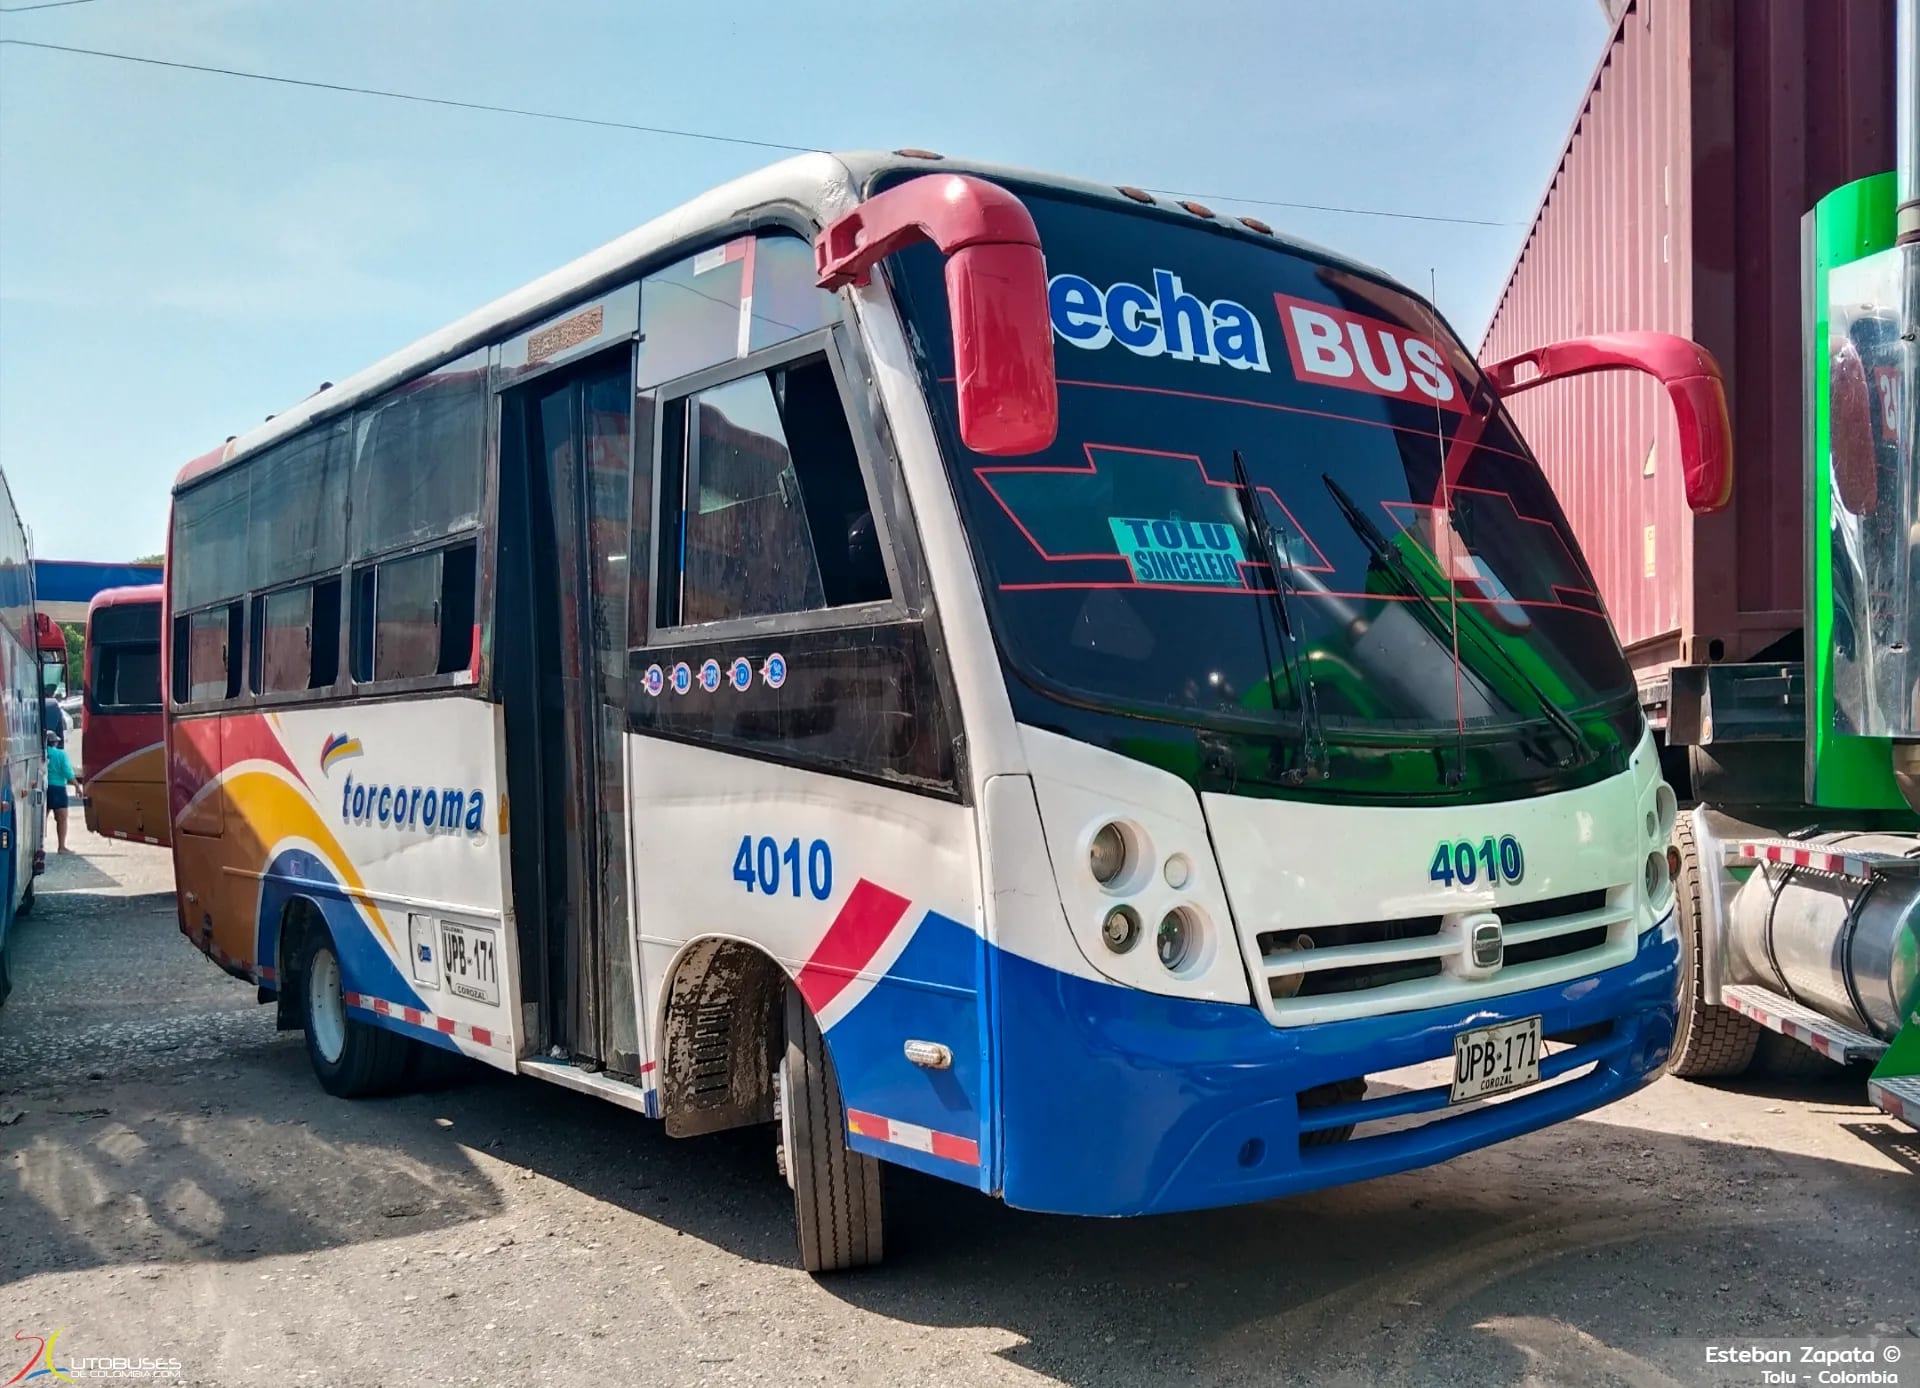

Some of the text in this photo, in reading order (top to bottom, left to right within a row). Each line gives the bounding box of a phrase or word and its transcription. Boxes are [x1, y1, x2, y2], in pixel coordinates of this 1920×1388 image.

[1047, 266, 1454, 401] echa BUS
[1122, 519, 1232, 550] TOLU
[1133, 550, 1242, 580] SINCELEJO
[342, 770, 485, 833] torcoroma
[733, 835, 832, 900] 4010
[1430, 836, 1523, 887] 4010
[457, 985, 487, 1000] COROZAL
[1480, 1074, 1513, 1090] COROZAL
